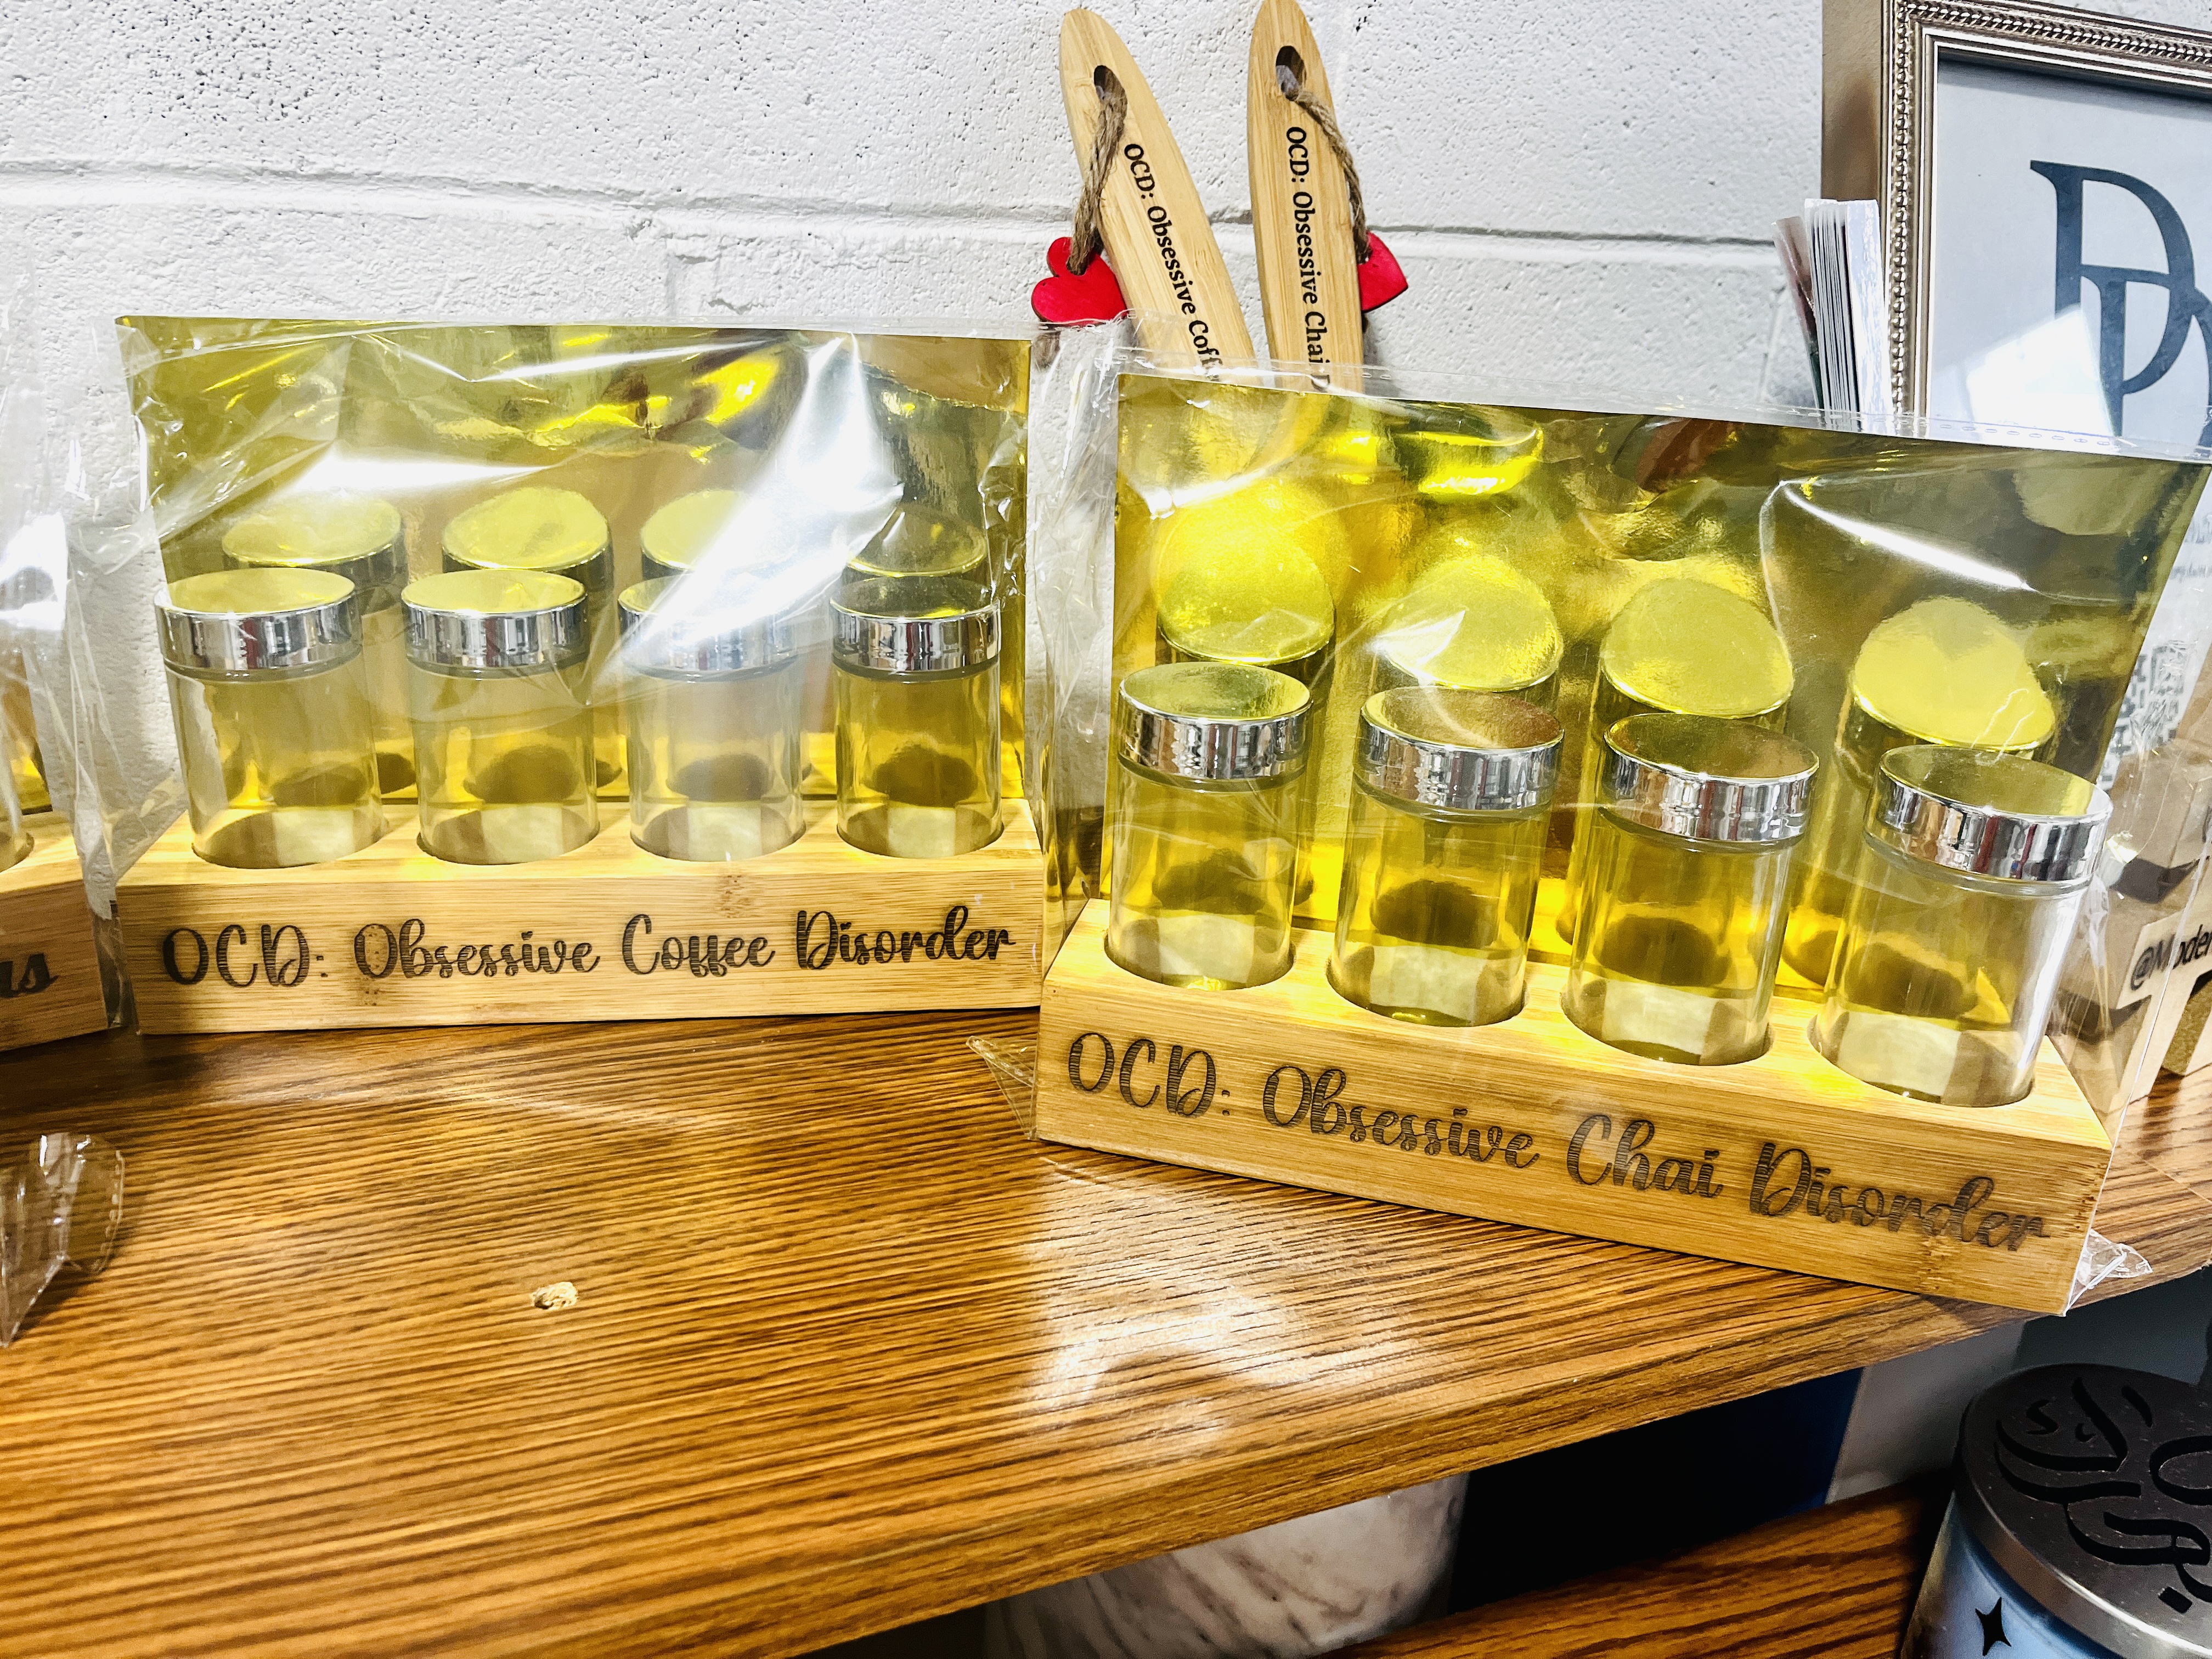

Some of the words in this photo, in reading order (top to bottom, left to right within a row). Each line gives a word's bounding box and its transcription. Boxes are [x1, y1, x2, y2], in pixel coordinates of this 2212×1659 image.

[1286, 127, 1310, 183] OCD:
[1124, 144, 1155, 199] OCD:
[1147, 206, 1196, 315] Obsessive
[1293, 191, 1322, 304] Obsessive
[1305, 311, 1330, 364] Chai
[162, 923, 329, 988] OCD:
[354, 918, 601, 979] Obsessive
[622, 913, 776, 978] Coffee
[796, 905, 1015, 970] Disorder
[1068, 1032, 1231, 1119] OCD:
[1262, 1065, 1541, 1169] Obsessive
[1566, 1114, 1723, 1199] Chai
[1749, 1141, 2050, 1251] Disorder
